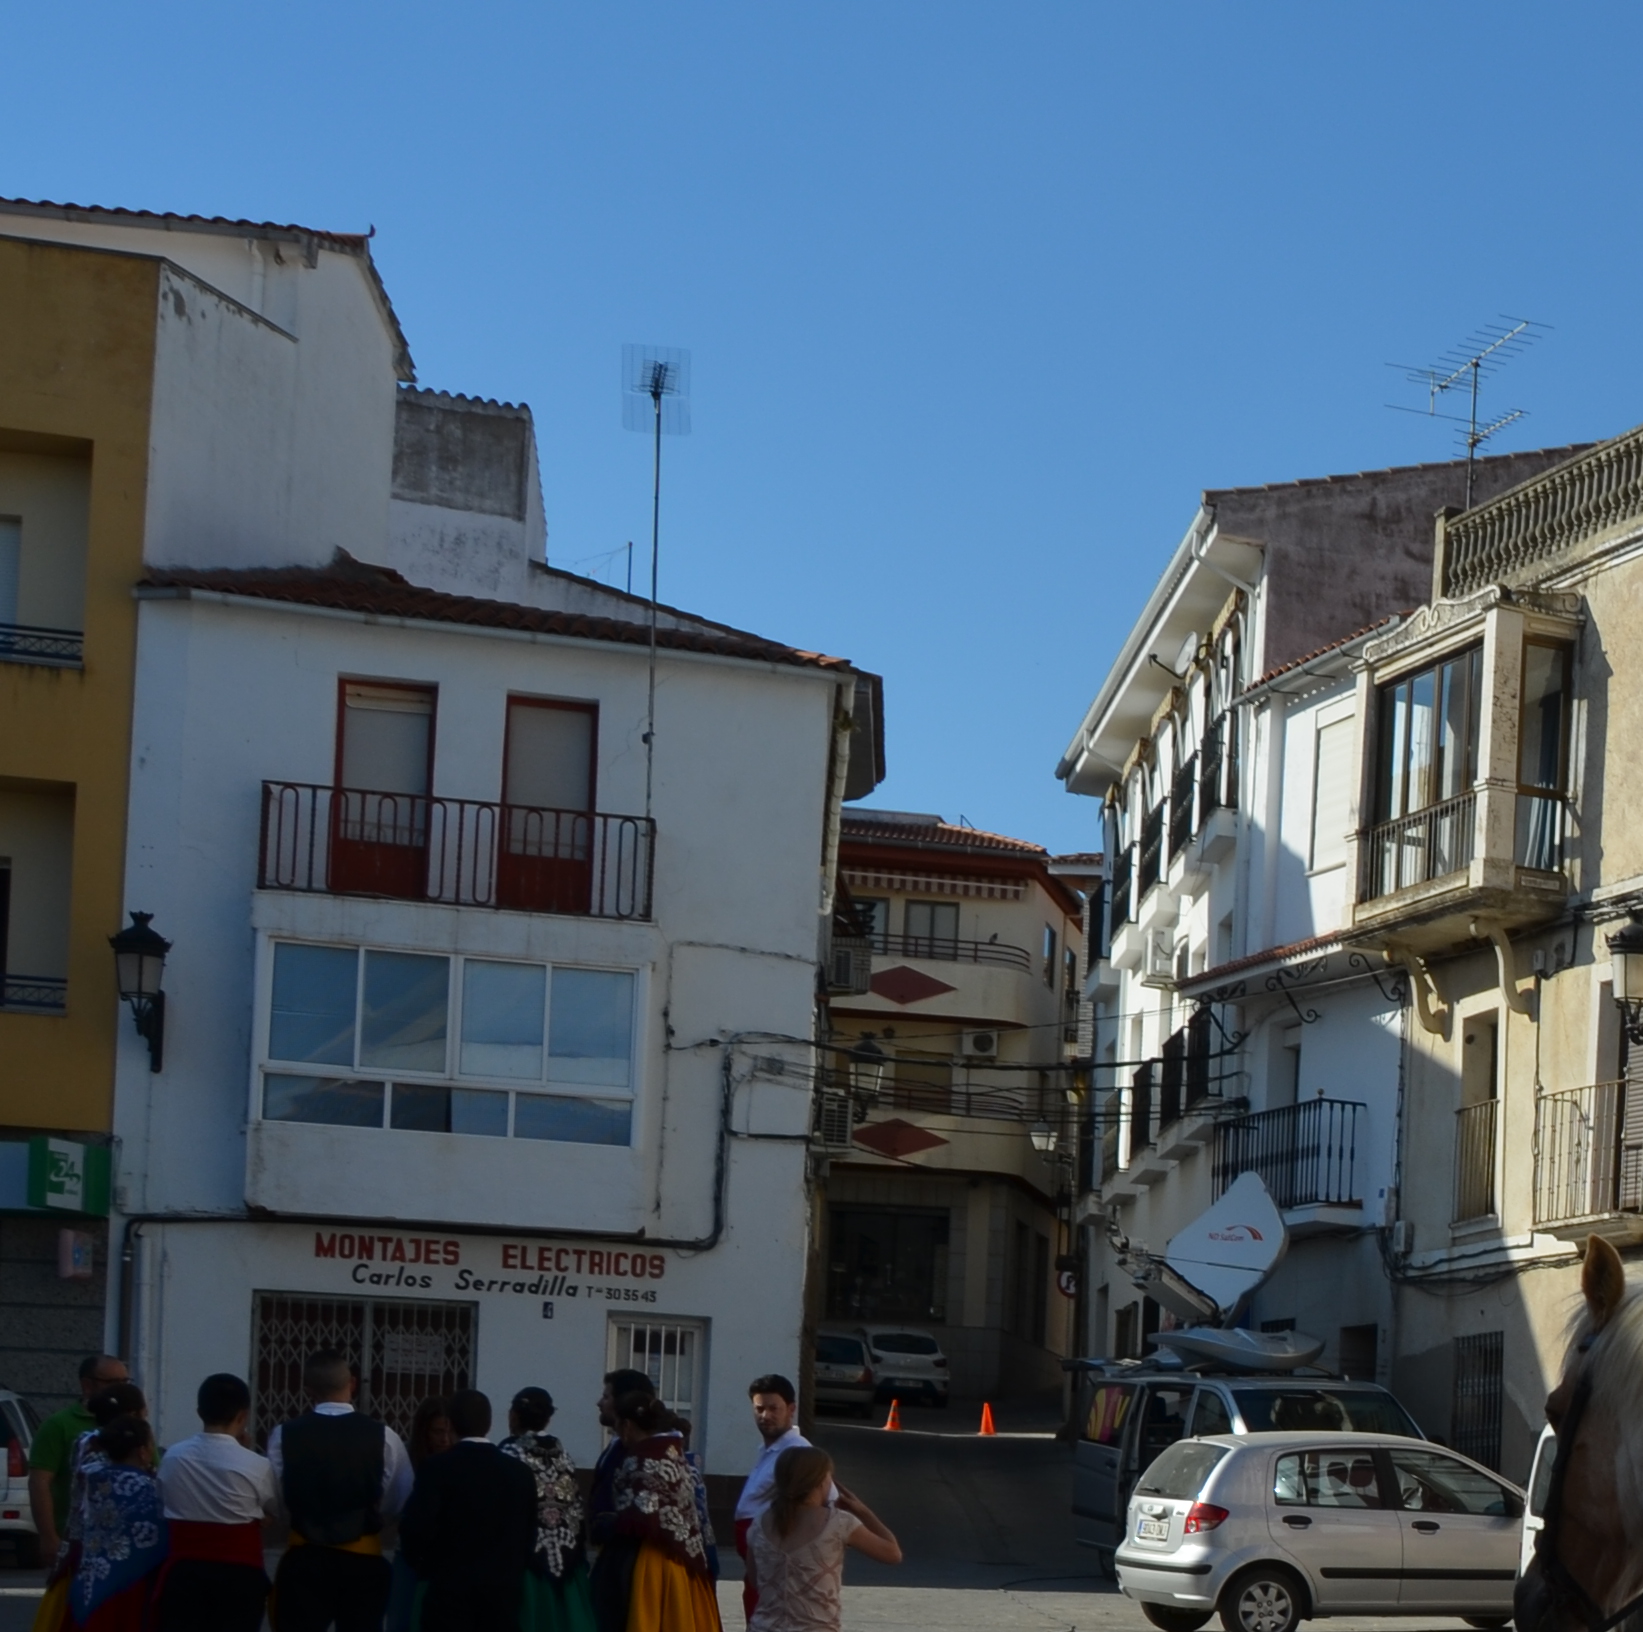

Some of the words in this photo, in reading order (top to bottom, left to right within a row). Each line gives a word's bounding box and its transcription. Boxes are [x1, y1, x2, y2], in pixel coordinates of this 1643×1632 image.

[314, 1232, 461, 1266] MONTAJES
[501, 1243, 665, 1279] ELECTRICOS
[351, 1263, 433, 1289] Carlos
[454, 1269, 579, 1298] Serradilla
